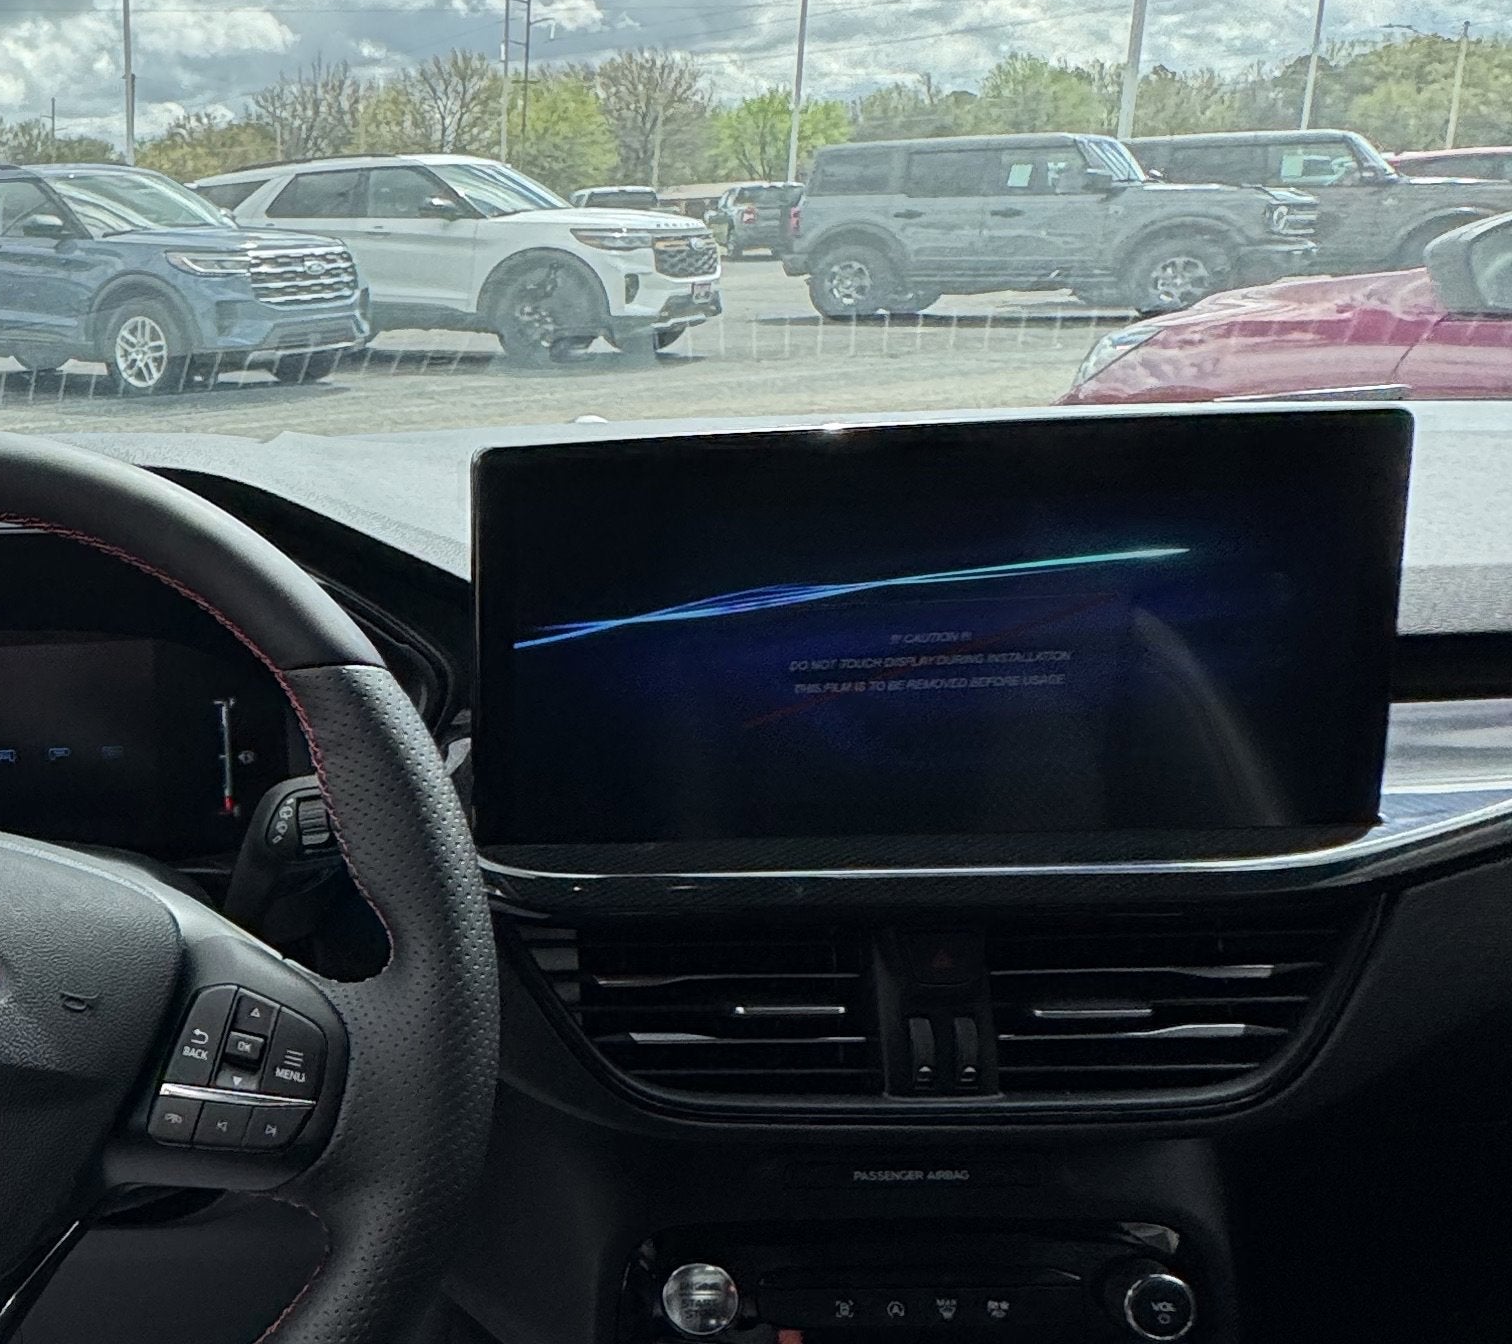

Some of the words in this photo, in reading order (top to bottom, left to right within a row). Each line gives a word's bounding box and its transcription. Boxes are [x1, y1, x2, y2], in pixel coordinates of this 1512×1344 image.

[904, 632, 960, 644] CAUTION
[789, 660, 808, 671] DO
[811, 659, 838, 670] NOT
[839, 658, 882, 669] TOUCH
[884, 656, 935, 668] DISPLAY
[937, 654, 983, 665] DURING
[986, 651, 1071, 663] INSTALLATION
[794, 683, 822, 694] THIS
[823, 682, 854, 693] FILM
[855, 682, 867, 692] IS
[869, 681, 886, 691] TO
[887, 680, 906, 691] BE
[907, 678, 968, 690] REMOVED
[969, 676, 1021, 688] BEFORE
[1022, 674, 1065, 685] USAGE
[182, 1046, 209, 1061] BACK
[237, 1041, 252, 1053] OK
[275, 1066, 306, 1083] MENU
[853, 1170, 923, 1181] PASSENGER
[926, 1170, 969, 1180] AIRBAG
[1151, 1301, 1177, 1312] VOL
